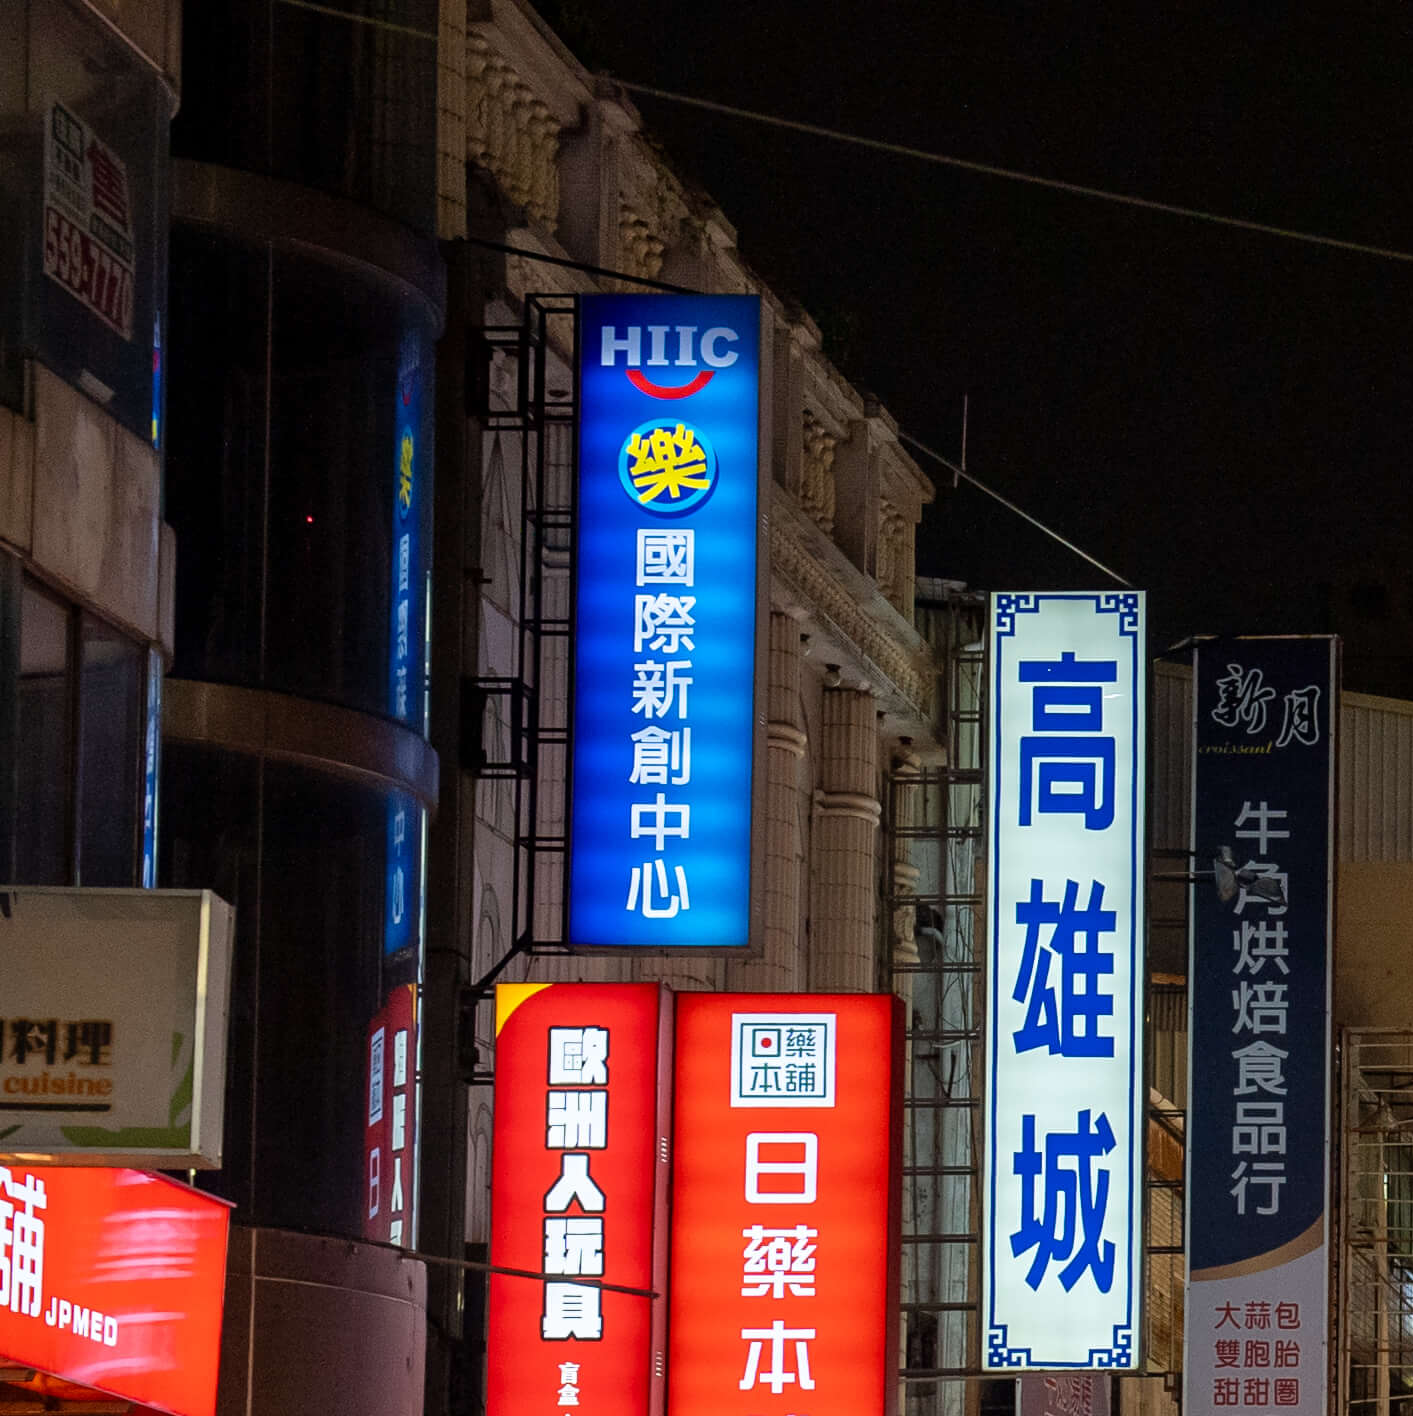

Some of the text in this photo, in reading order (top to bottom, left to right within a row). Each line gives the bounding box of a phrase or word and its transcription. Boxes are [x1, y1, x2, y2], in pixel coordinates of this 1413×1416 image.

[601, 326, 739, 367] HIIC
[628, 423, 710, 504] 樂
[626, 528, 696, 919] 國際新創中心
[1211, 664, 1320, 747] 新月
[1011, 652, 1118, 1290] 高雄城
[0, 1019, 112, 1066] 料理
[541, 1025, 611, 1341] 歐洲人玩具
[45, 1297, 118, 1347] JPMED
[1214, 1301, 1300, 1330] 大蒜包
[1214, 1340, 1299, 1368] 雙胞胎
[1213, 1377, 1299, 1406] 甜甜圈
